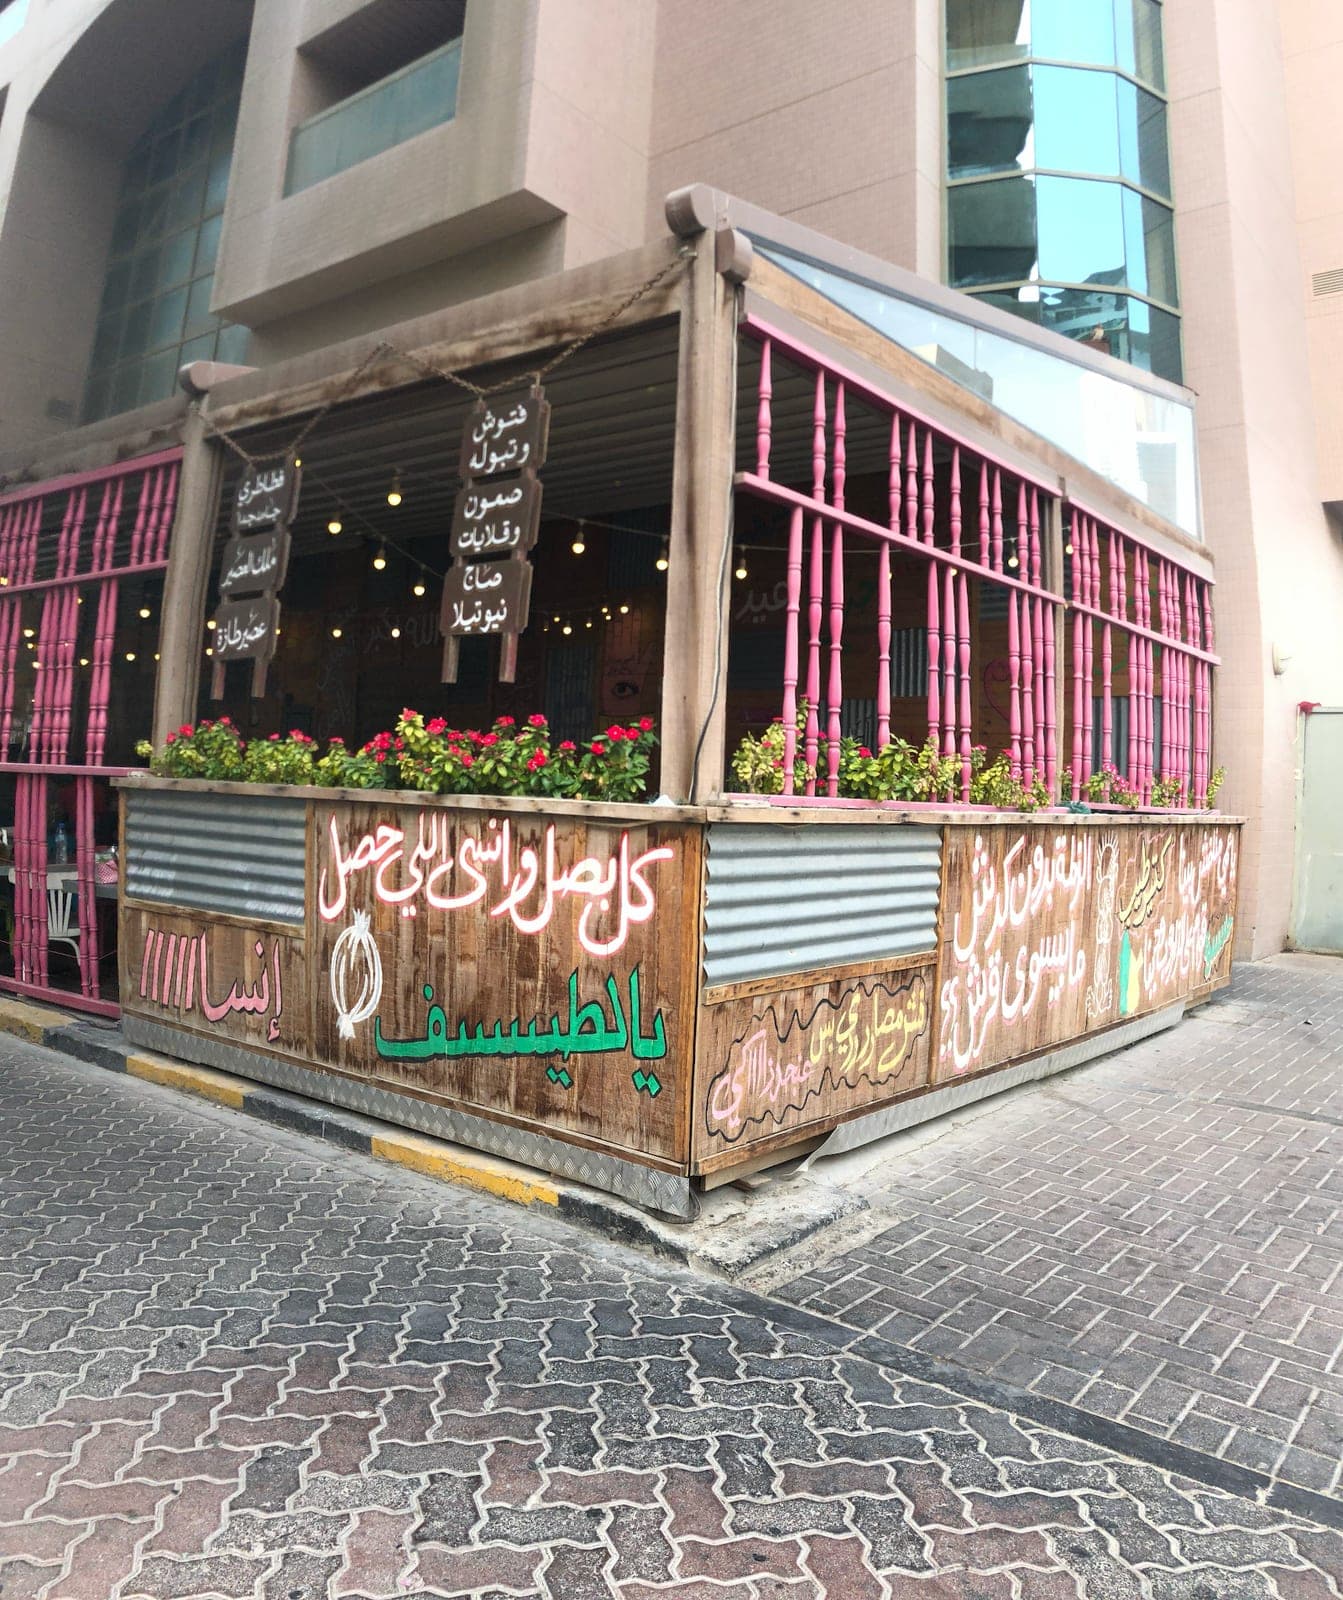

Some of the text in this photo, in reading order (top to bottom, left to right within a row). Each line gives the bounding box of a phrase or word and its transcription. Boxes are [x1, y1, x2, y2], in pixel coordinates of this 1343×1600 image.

[472, 404, 528, 442] فتوش
[464, 487, 523, 520] صمون
[458, 521, 521, 552] وقلايات
[462, 562, 503, 592] صاج
[451, 598, 507, 634] نيوتيلا
[318, 810, 406, 923] حصل
[511, 822, 617, 933] بصل
[577, 830, 674, 957] كل
[1010, 843, 1056, 928] بدون
[953, 833, 1027, 967] كرش
